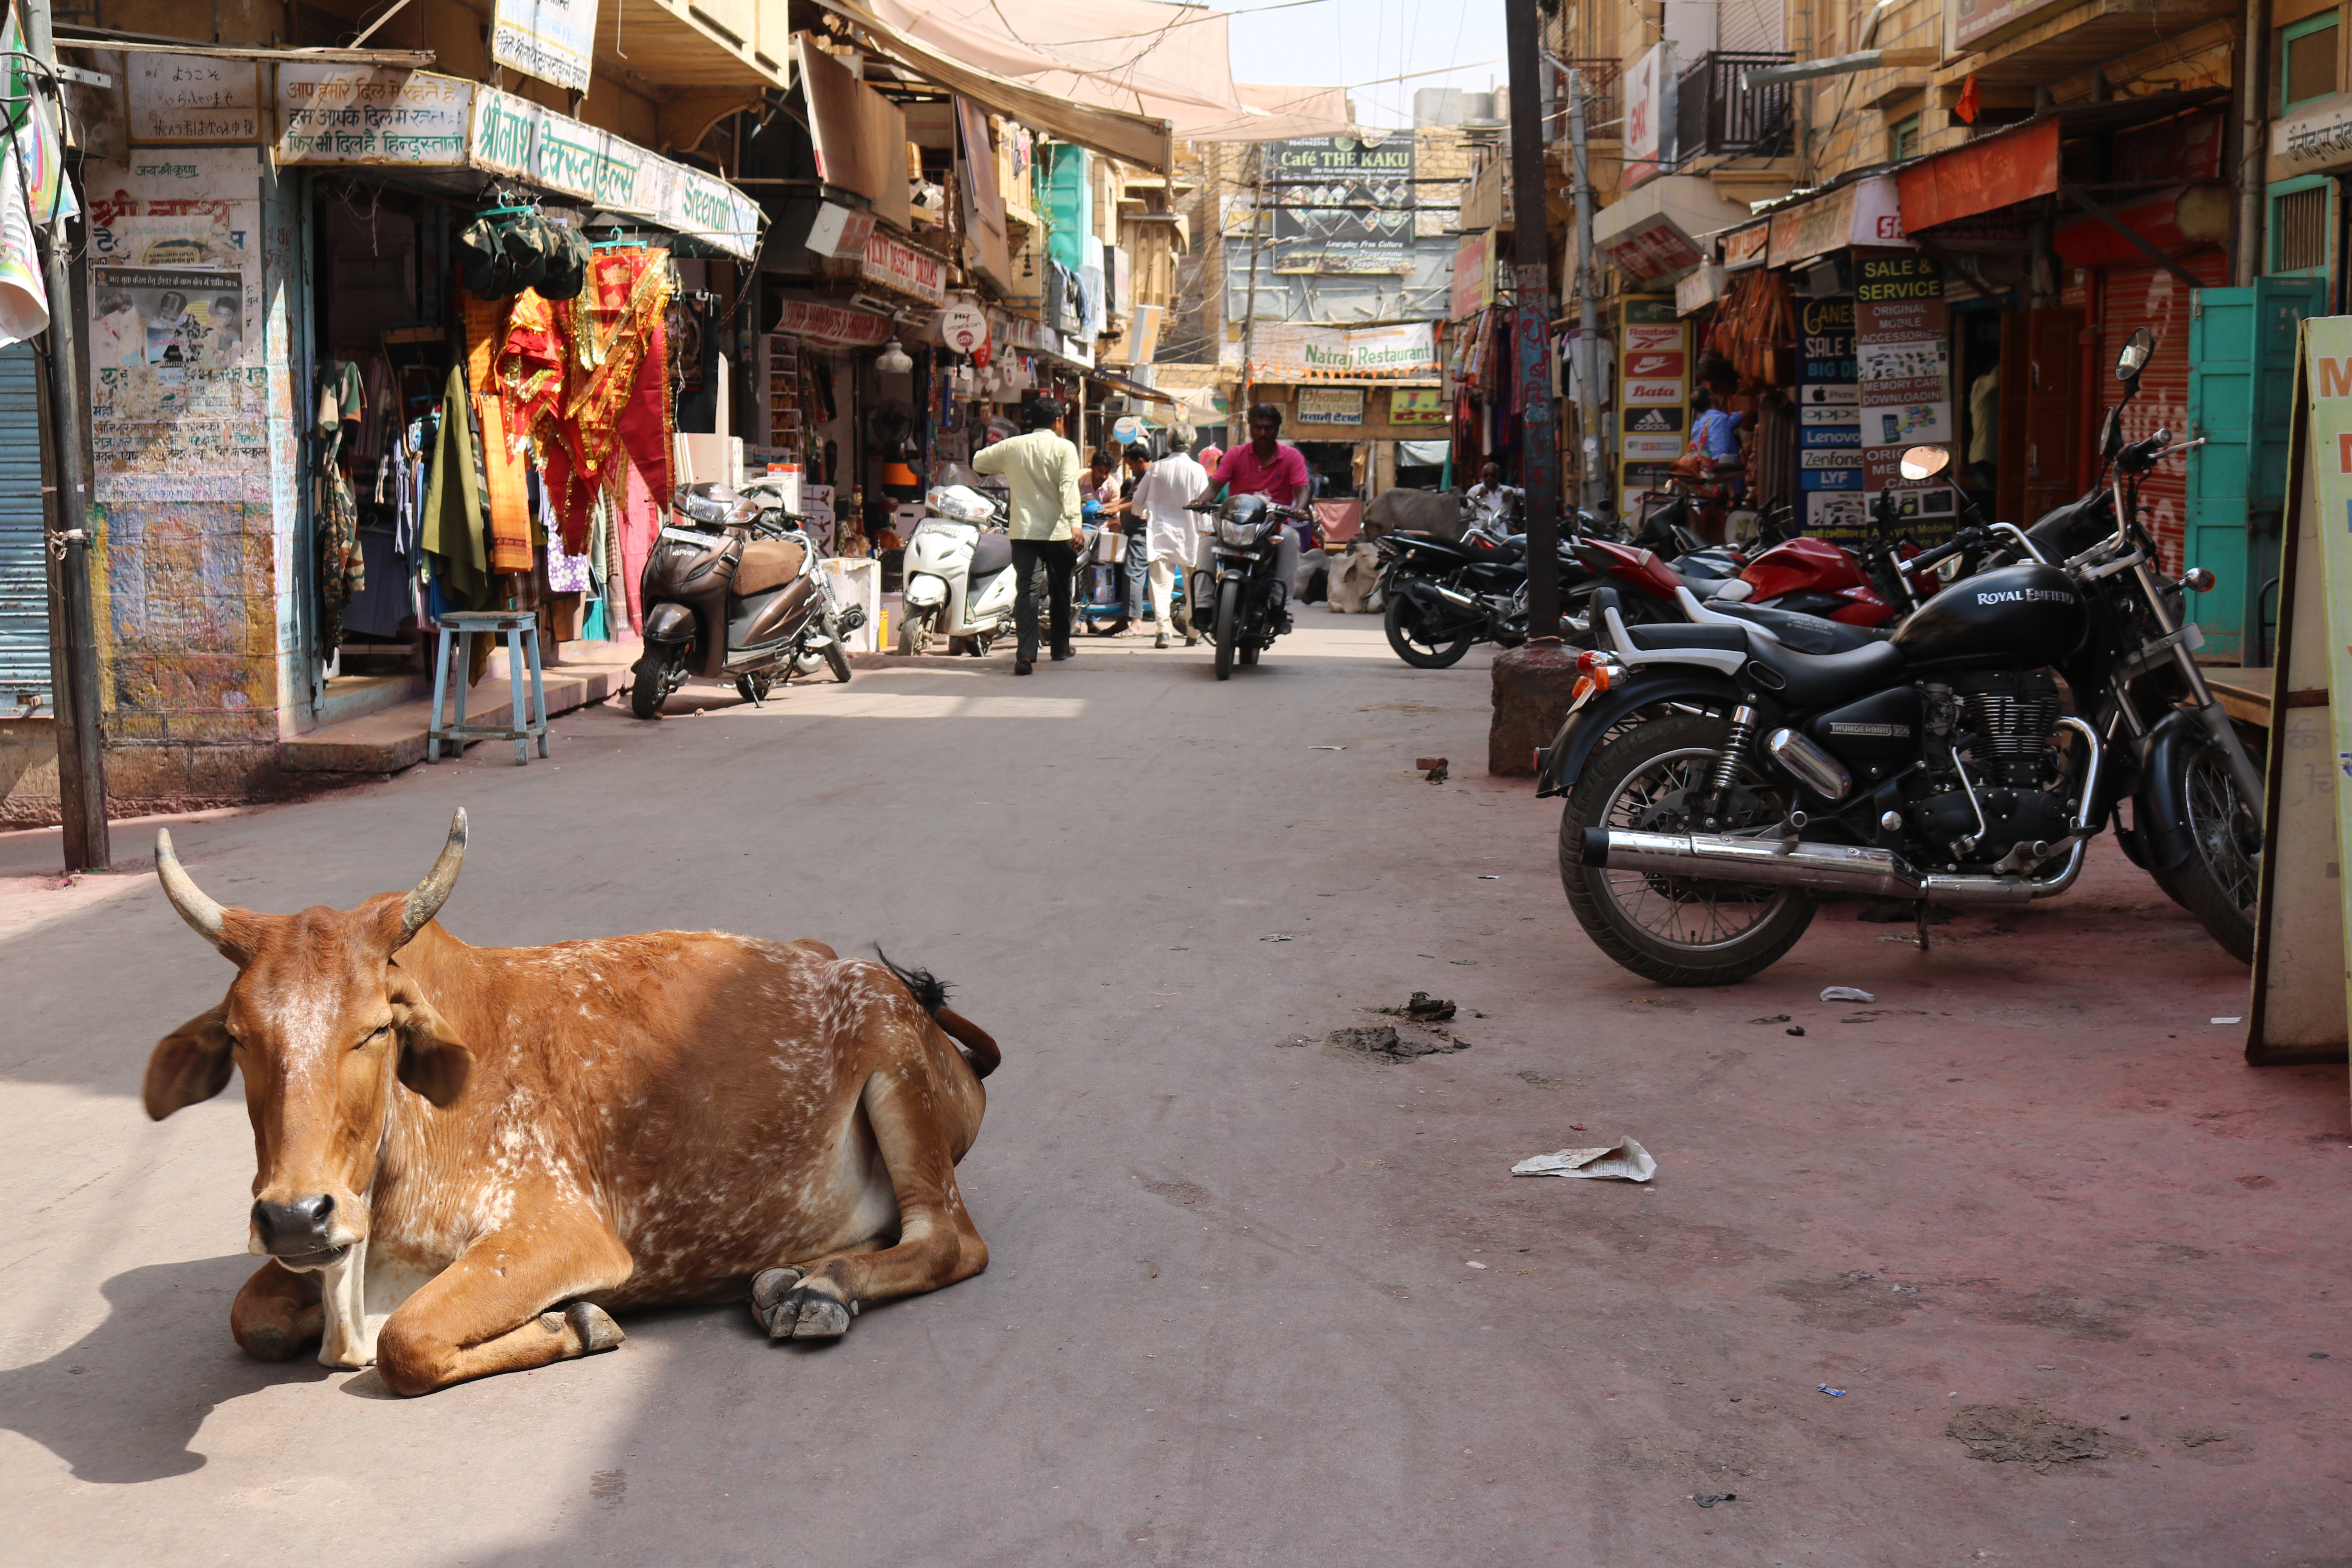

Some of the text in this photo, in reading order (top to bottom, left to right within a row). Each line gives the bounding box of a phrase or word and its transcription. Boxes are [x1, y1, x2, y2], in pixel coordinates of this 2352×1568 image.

[173, 66, 220, 81] ようこそ
[287, 82, 315, 100] आप
[355, 77, 386, 103] दिल
[403, 81, 440, 105] रहते
[165, 91, 233, 107] いらっしゃいませ
[289, 108, 315, 130] हम
[316, 105, 361, 127] आपके
[363, 104, 393, 130] दिल
[479, 94, 535, 174] श्रीनाथ
[287, 130, 316, 154] फिर
[316, 131, 333, 153] भी
[381, 131, 464, 160] हिन्दुस्तानी
[1281, 151, 1409, 167] Café THE KAKU
[135, 165, 159, 177] जय
[683, 176, 731, 234] Sreenath
[1359, 249, 1402, 258] Programme
[1864, 258, 1932, 278] SALE &
[1858, 280, 1940, 301] SERVICE
[1872, 304, 1927, 317] ORIGINAL
[1879, 317, 1922, 329] MOBILE
[1629, 328, 1679, 336] Reebok
[1861, 329, 1941, 344] ACCESSORIES
[1805, 337, 1844, 358] SALE
[1305, 343, 1354, 370] Natraj
[1358, 341, 1431, 364] Restaurant
[1639, 356, 1666, 367] NIKE
[1808, 362, 1836, 377] BIG
[1632, 385, 1675, 397] Bata
[1864, 377, 1946, 392] MEMORY CARD
[1828, 390, 1855, 399] iPhone
[1863, 390, 1948, 405] DOWNLOADING
[1634, 421, 1671, 431] adidas
[1807, 431, 1861, 444] Lenovo
[1804, 450, 1863, 466] Zenfone
[1820, 471, 1848, 484] LYF
[1917, 523, 1953, 534] Mobile
[698, 535, 717, 545] 4723
[672, 548, 696, 557] मोनिका
[1977, 588, 2075, 605] ROYAL ENFIELD
[1830, 722, 1910, 737] THUNDERBIRD 350
